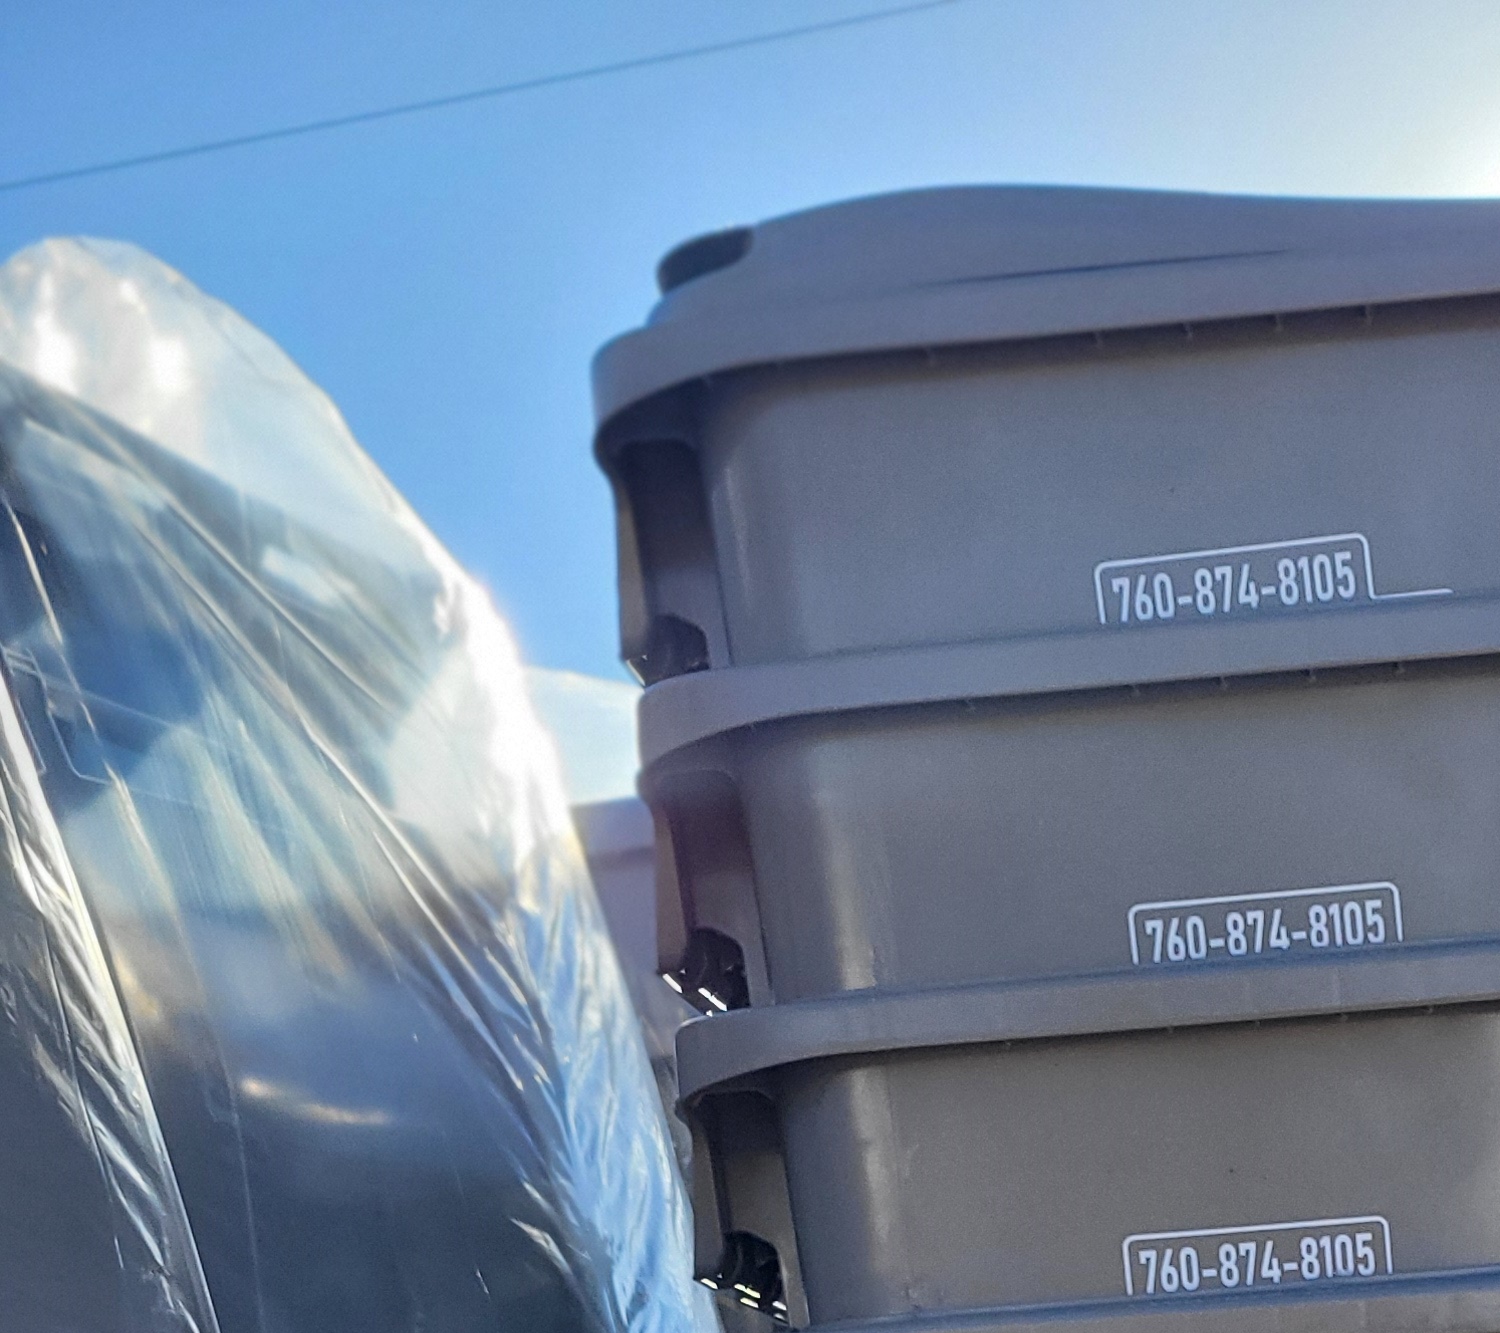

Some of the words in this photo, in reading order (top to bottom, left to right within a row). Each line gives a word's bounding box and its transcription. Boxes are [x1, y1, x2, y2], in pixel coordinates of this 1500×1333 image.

[1112, 551, 1356, 623] 760-874-8105
[1145, 900, 1386, 963] 760-874-8105
[1138, 1233, 1376, 1293] 760-874-8105
